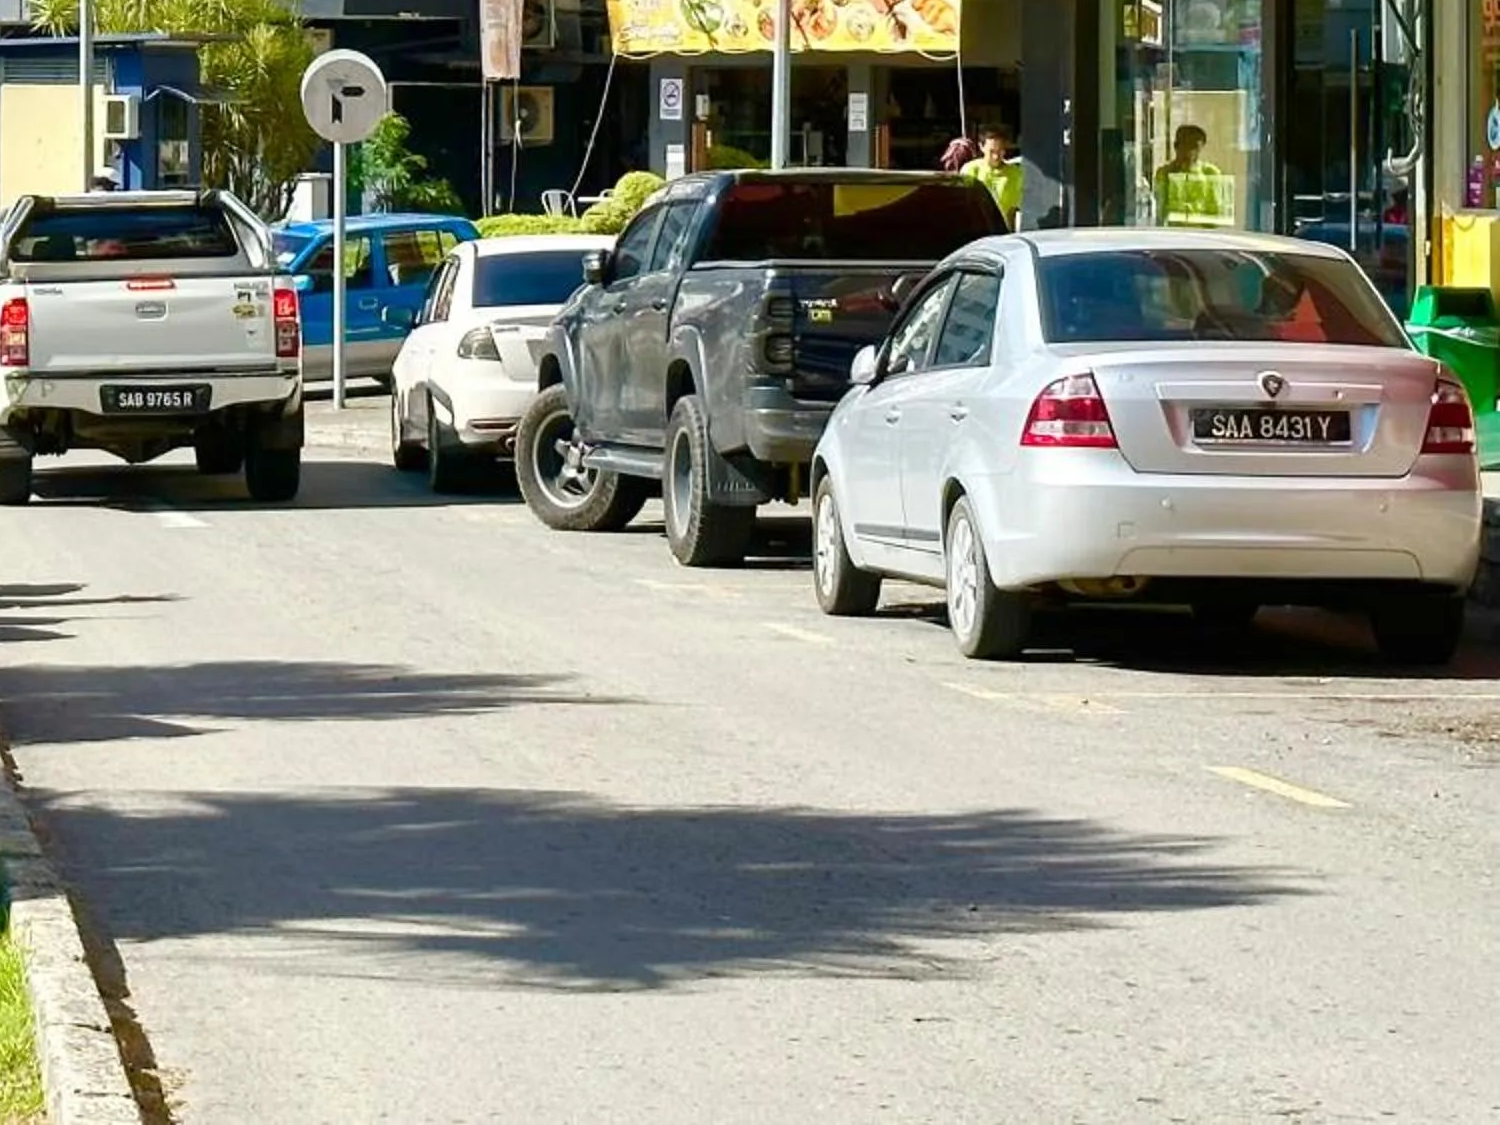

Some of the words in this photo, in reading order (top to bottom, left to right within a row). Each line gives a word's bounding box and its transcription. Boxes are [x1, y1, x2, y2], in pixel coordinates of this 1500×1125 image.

[118, 391, 145, 408] SAB
[1211, 414, 1253, 438] SAA
[1260, 415, 1313, 439] 8431
[1318, 415, 1332, 440] Y
